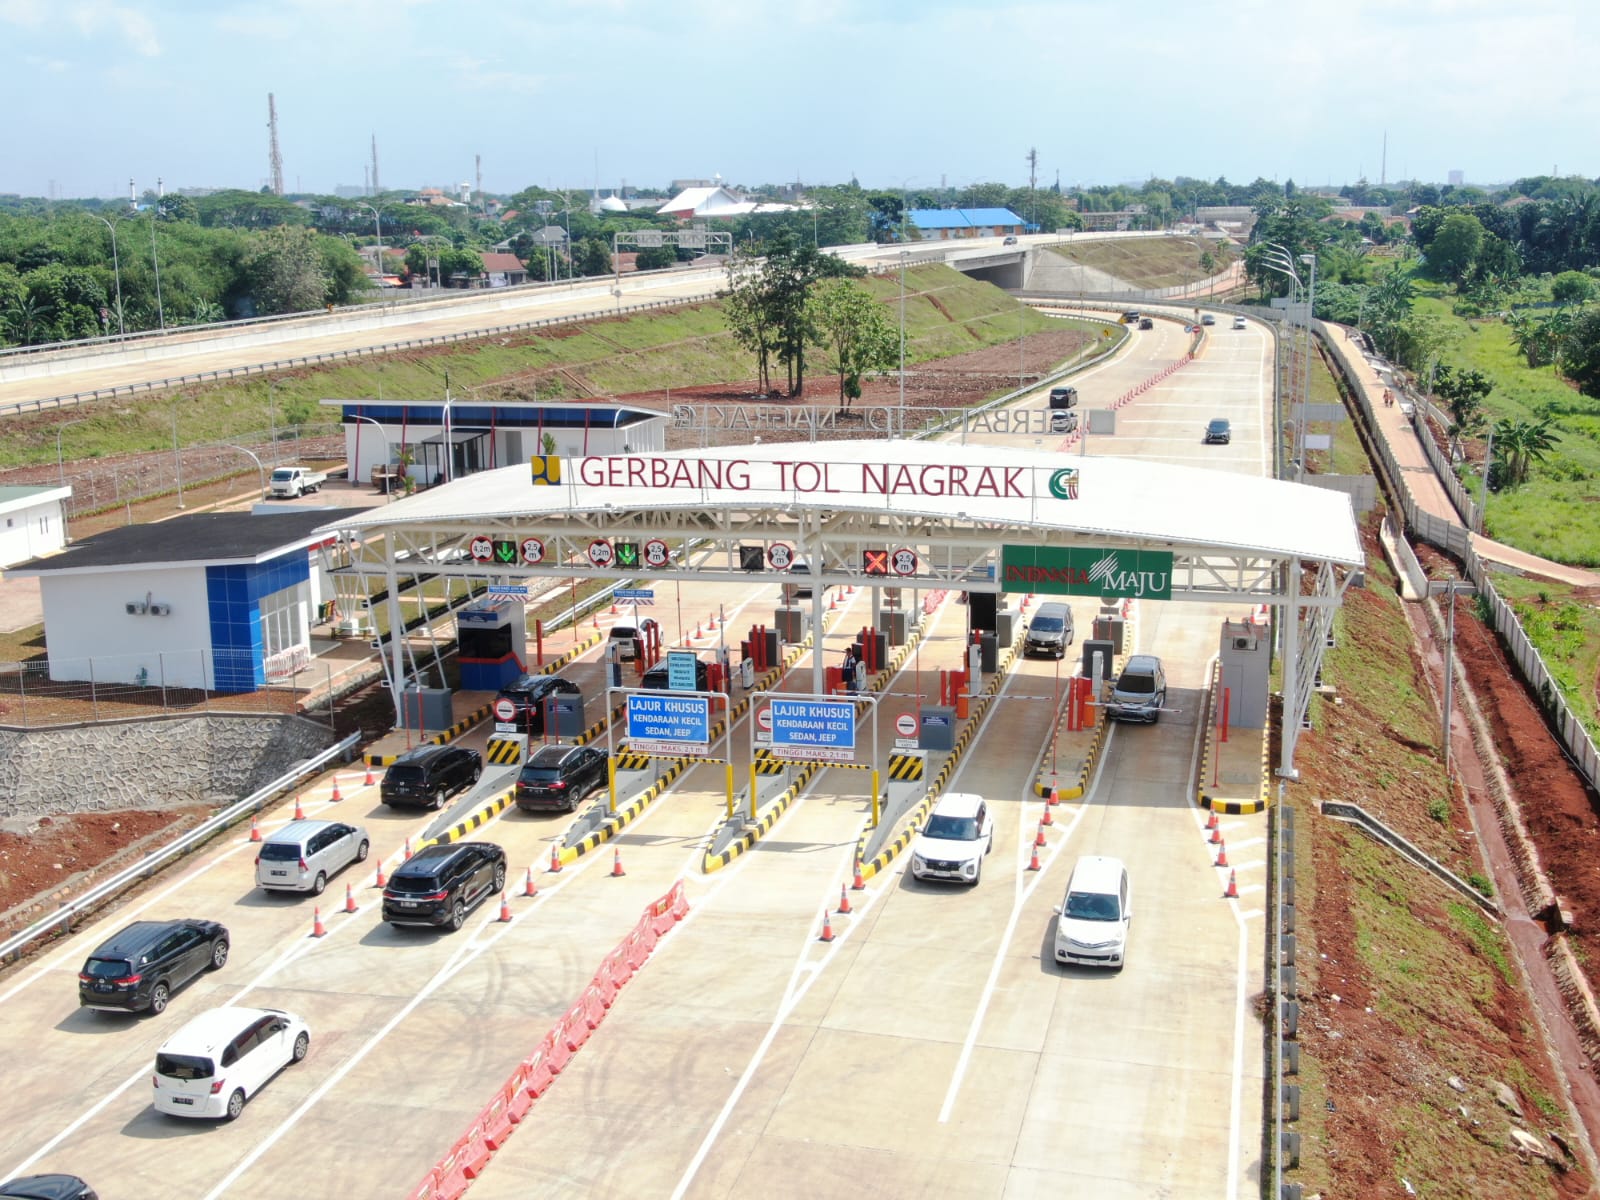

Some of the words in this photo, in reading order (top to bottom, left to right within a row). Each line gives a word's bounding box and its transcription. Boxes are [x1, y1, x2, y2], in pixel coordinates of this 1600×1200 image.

[580, 456, 751, 491] GERBANG
[772, 461, 841, 494] TOL
[861, 463, 1026, 498] NAGRAK
[473, 544, 491, 553] 4,2m
[527, 543, 538, 551] 2,5
[591, 547, 609, 557] 4,2m
[651, 545, 662, 553] 2,5
[774, 548, 786, 556] 2,5
[652, 553, 661, 561] m
[898, 554, 912, 562] 2,5
[1103, 571, 1167, 596] MAJU
[630, 699, 661, 712] LAJUR
[664, 702, 705, 714] KHUSUS
[774, 705, 806, 717] LAJUR
[809, 706, 851, 719] KHUSUS
[633, 714, 679, 725] KENDARAAN
[681, 717, 703, 726] KECIL
[776, 719, 825, 730] KENDARAAN
[826, 721, 849, 731] KECIL
[645, 727, 673, 736] SEDAN,
[674, 729, 691, 737] JEEP
[789, 732, 818, 742] SEDAN,
[818, 733, 837, 742] JEEP
[633, 743, 659, 751] TINGGI
[776, 748, 803, 756] TINGGI
